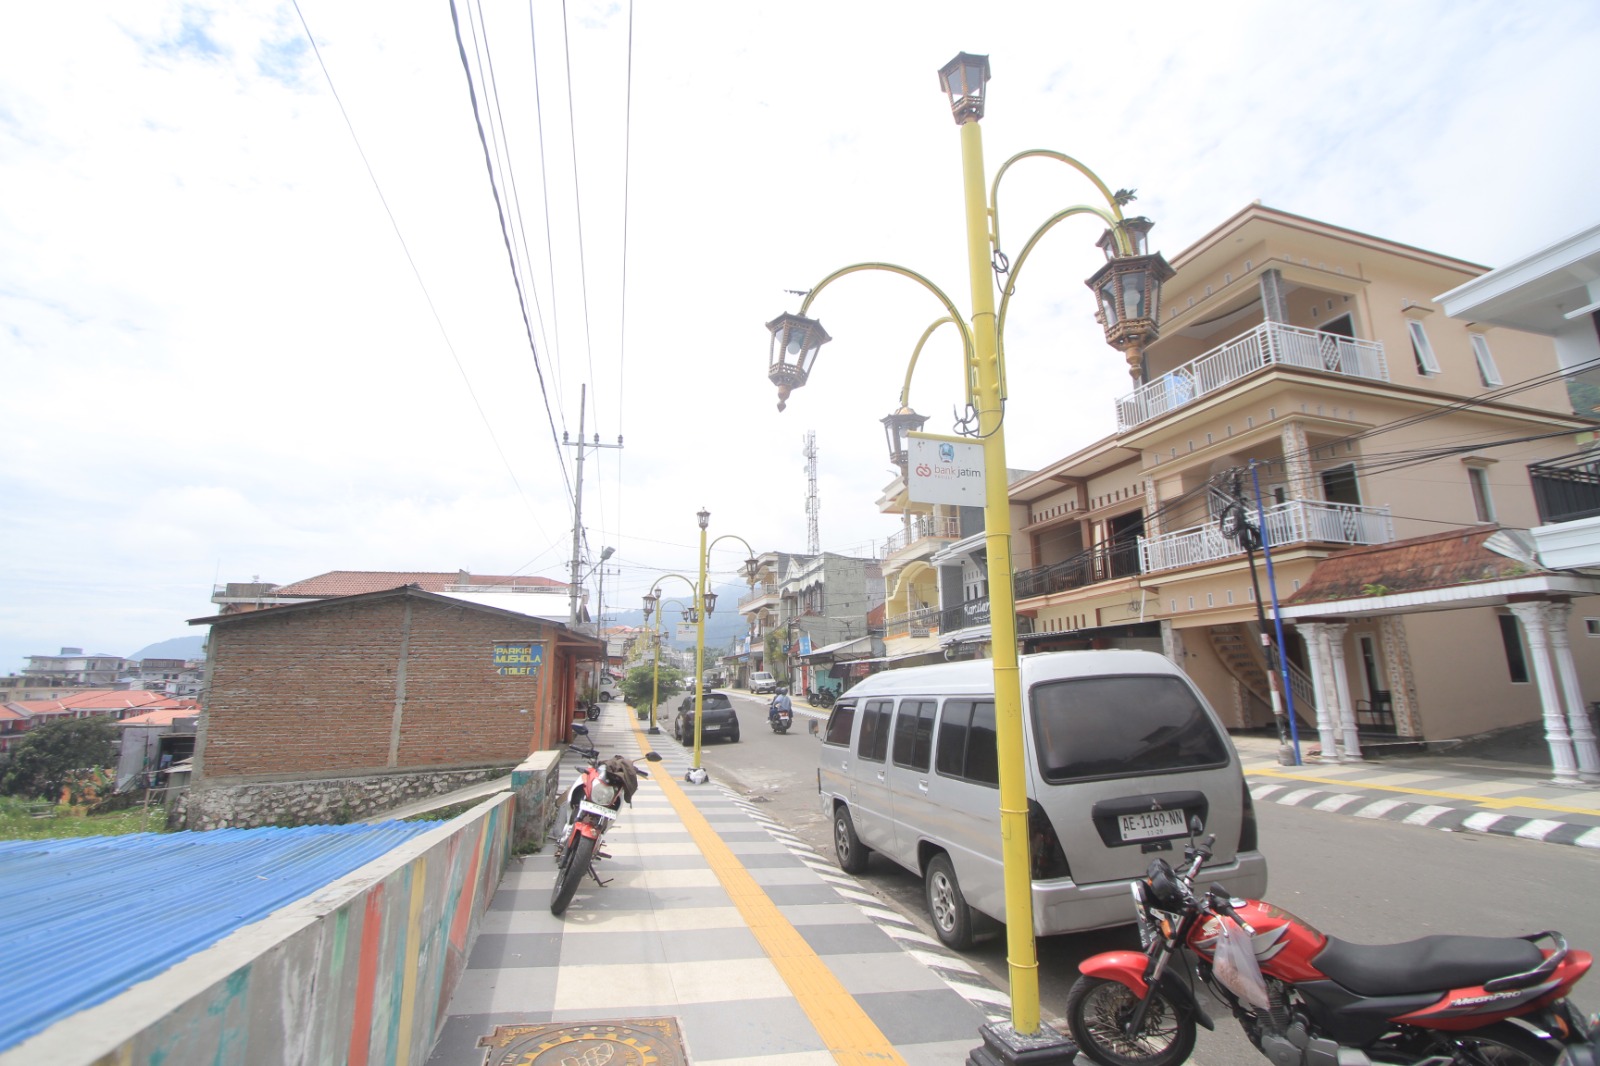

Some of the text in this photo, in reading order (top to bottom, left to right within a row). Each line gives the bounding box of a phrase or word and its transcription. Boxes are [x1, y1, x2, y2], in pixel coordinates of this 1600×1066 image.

[934, 464, 956, 475] bank
[956, 467, 981, 478] jatim
[496, 647, 531, 655] PARKIR
